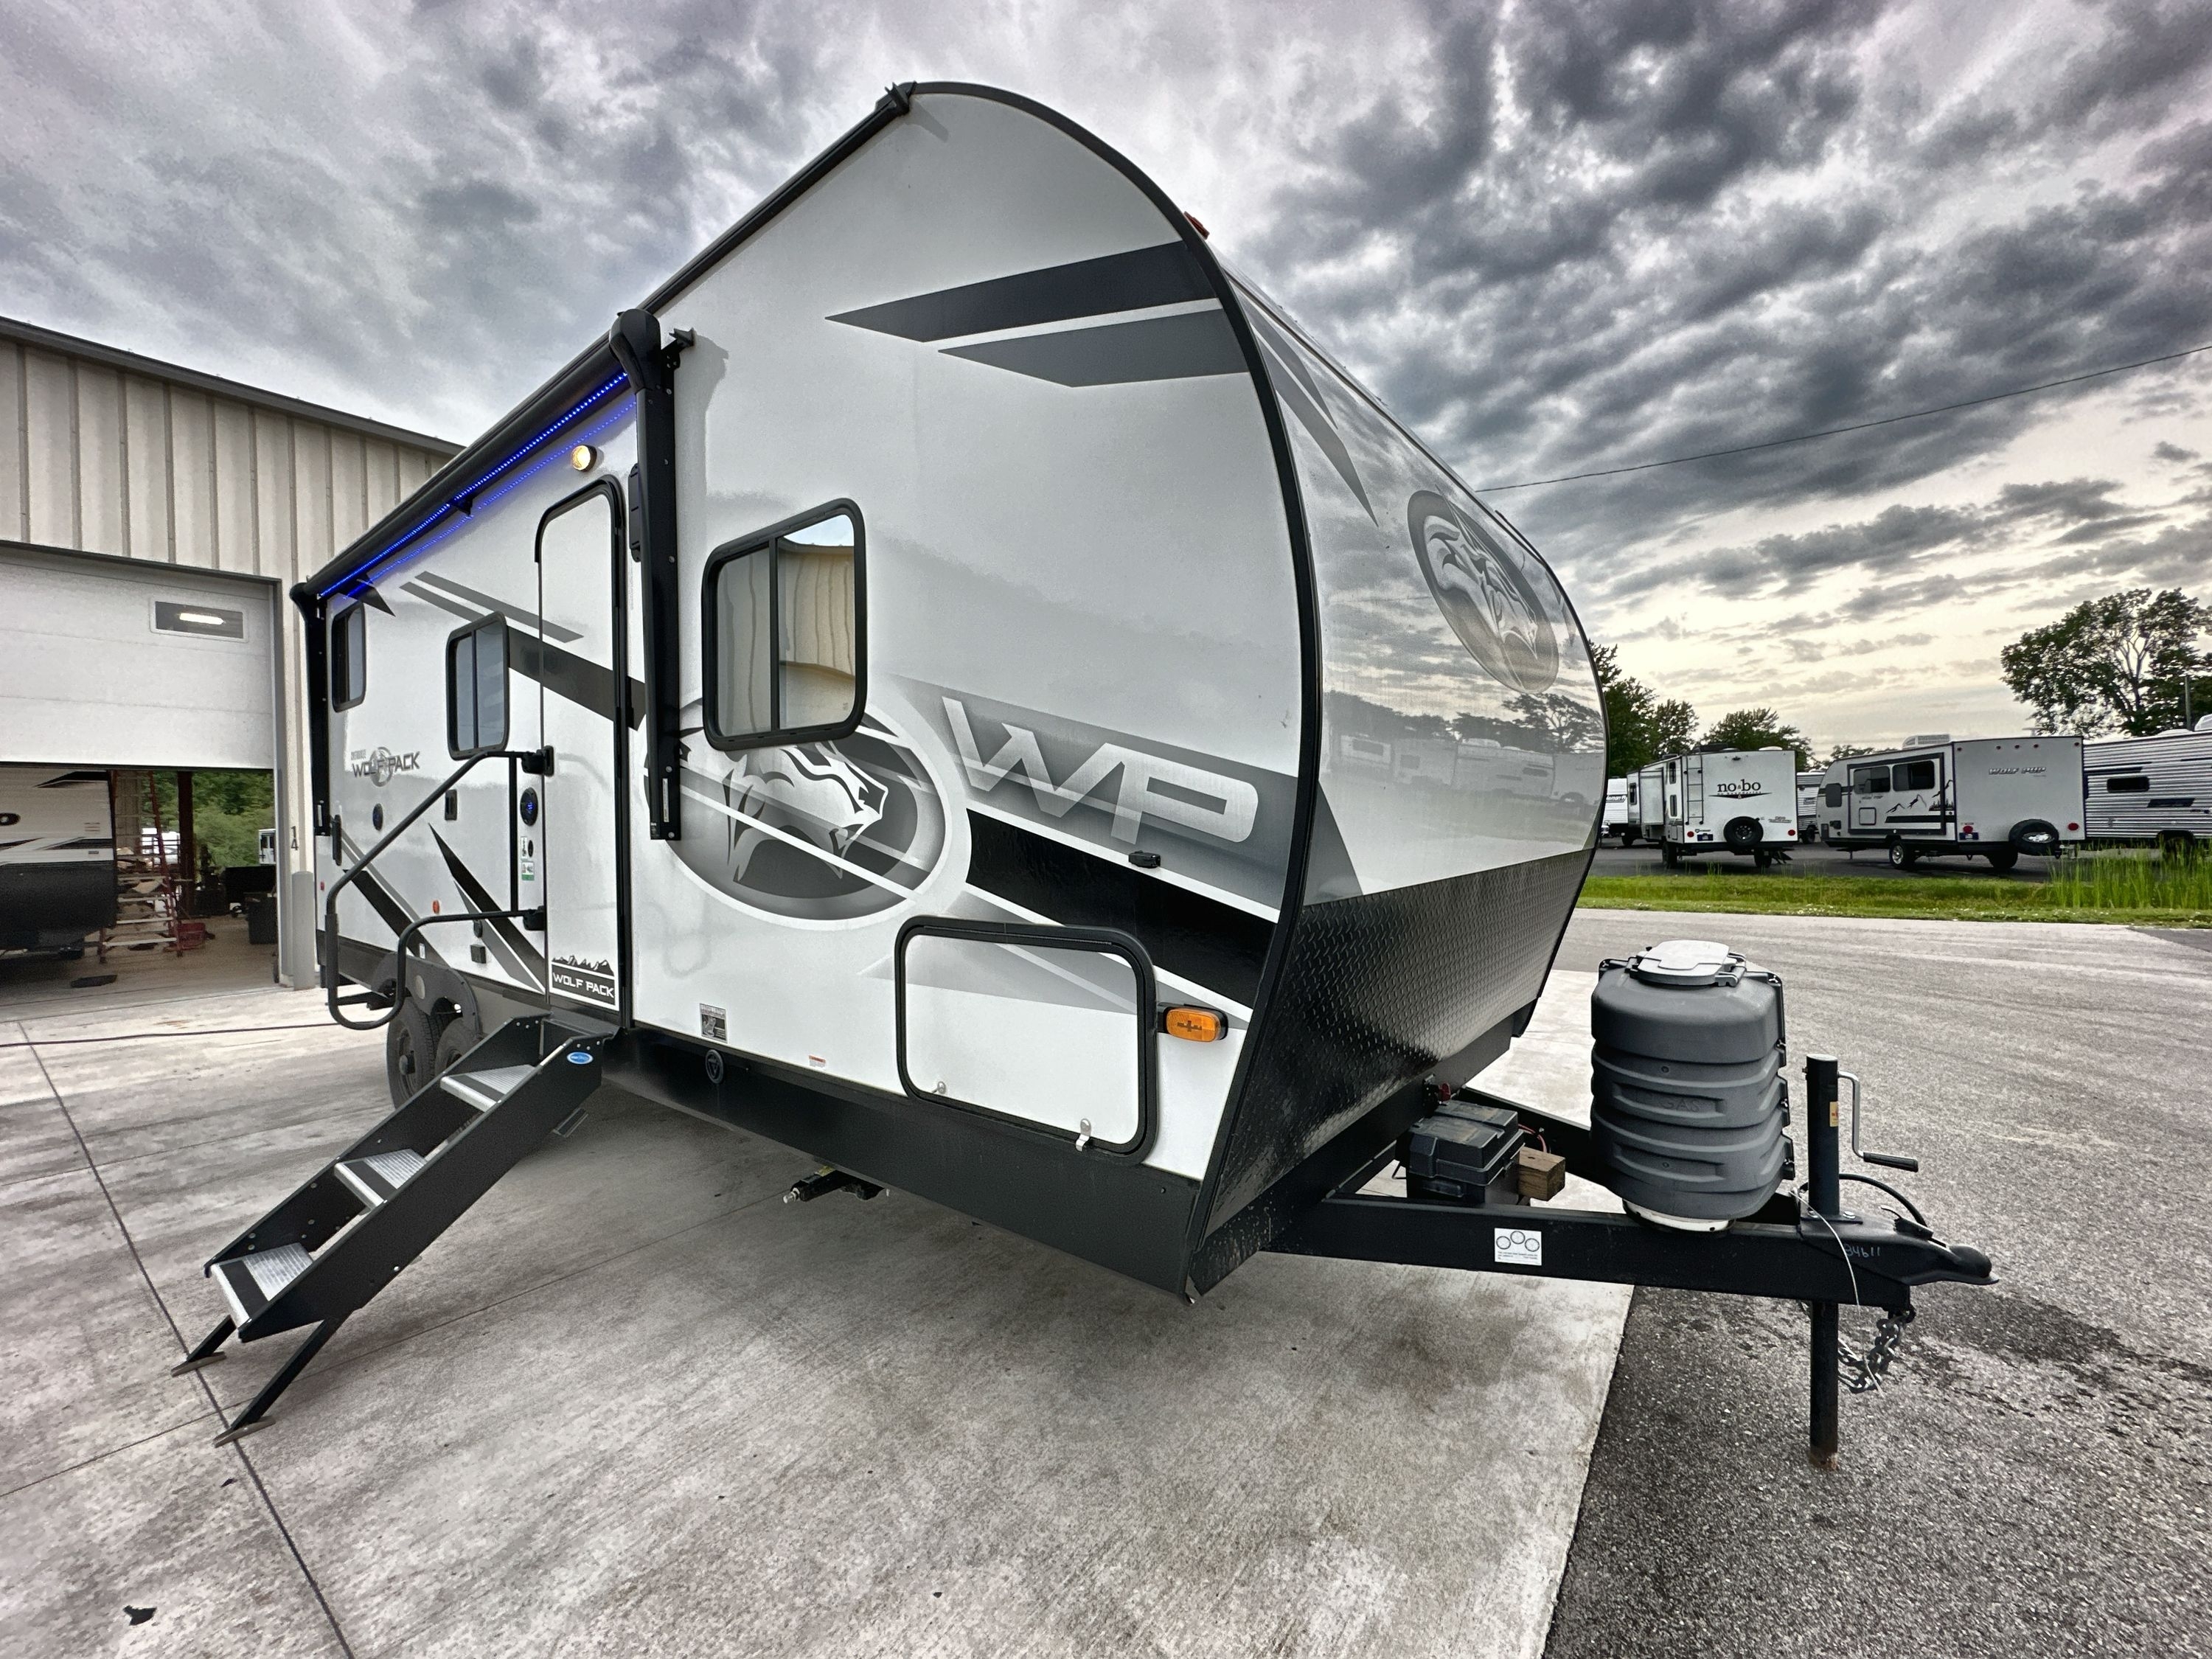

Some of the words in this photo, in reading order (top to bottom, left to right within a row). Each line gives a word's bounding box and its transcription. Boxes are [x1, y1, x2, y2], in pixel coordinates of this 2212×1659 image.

[352, 759, 386, 778] WOLF
[387, 751, 420, 773] PACK
[941, 696, 1259, 845] WP
[553, 972, 584, 988] WOLF
[585, 981, 614, 998] PACK
[1660, 1098, 1700, 1113] GAS
